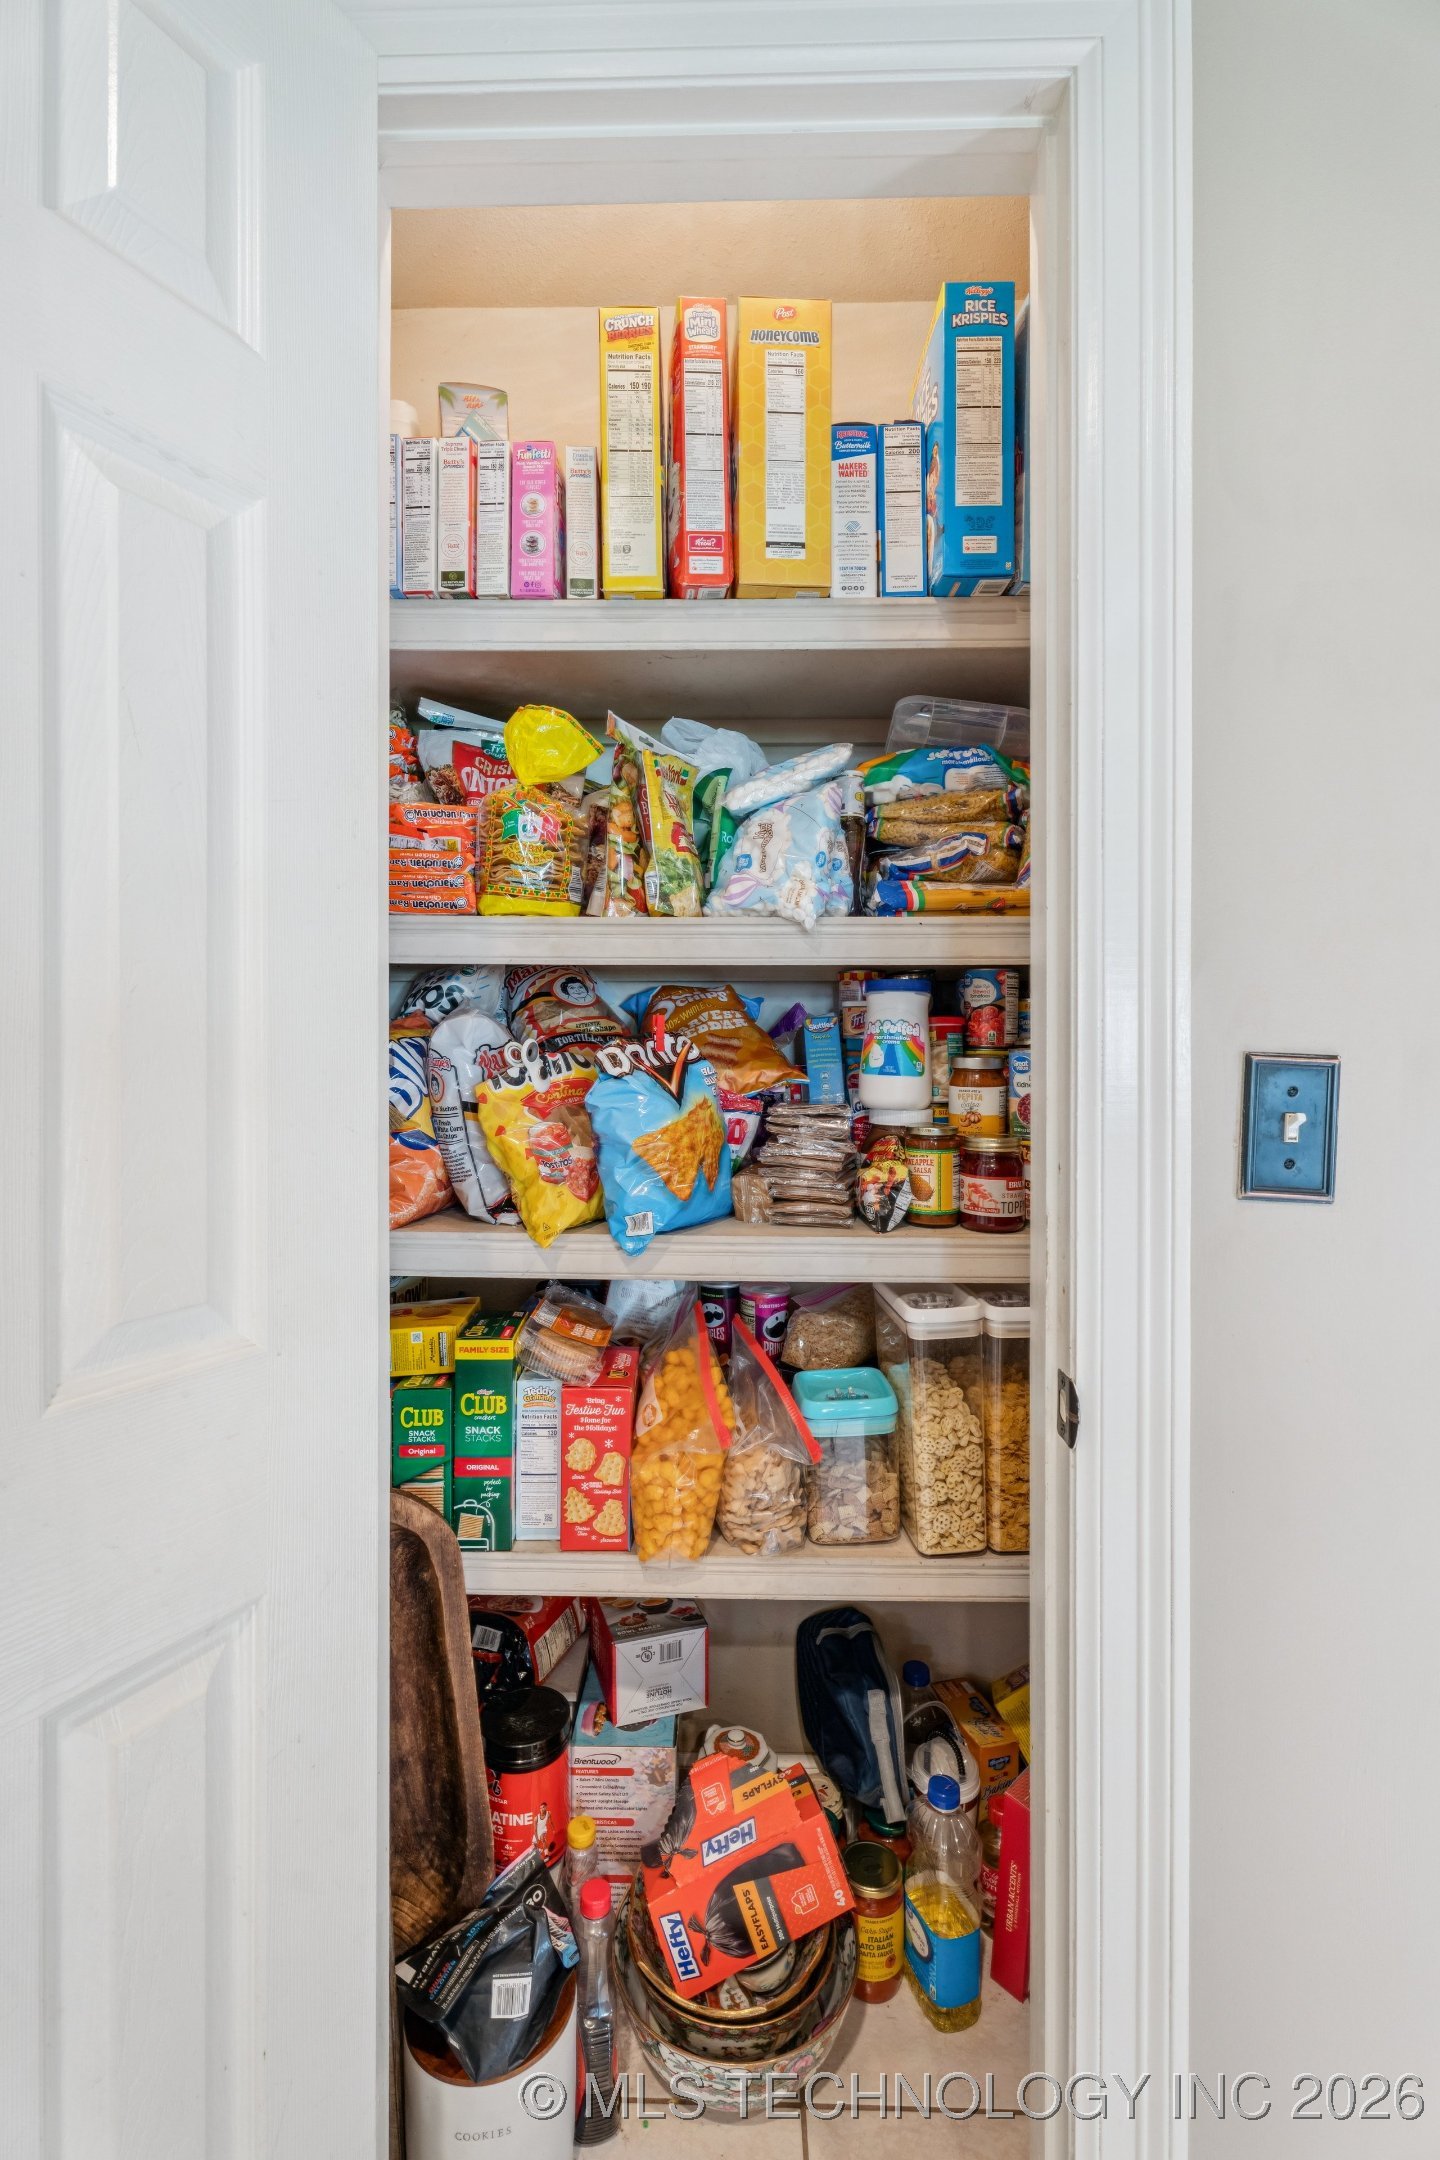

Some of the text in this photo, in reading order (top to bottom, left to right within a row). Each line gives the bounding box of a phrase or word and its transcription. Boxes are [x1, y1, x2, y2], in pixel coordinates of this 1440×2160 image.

[965, 300, 996, 312] RICE
[775, 307, 794, 319] Post
[605, 315, 655, 332] CRUNCH
[951, 312, 1008, 328] KRISPIES
[629, 382, 640, 390] 150
[641, 382, 652, 390] 190
[834, 441, 871, 449] Buttermilk
[838, 462, 868, 470] MAKERS
[838, 470, 868, 478] WANTED
[475, 756, 512, 776] CRIS
[461, 766, 519, 795] ONIO
[413, 809, 457, 818] Maruchan
[410, 858, 460, 869] Maruchan
[412, 879, 459, 888] Maruchan
[412, 900, 458, 910] Maruchan
[808, 1021, 835, 1031] Skittles
[555, 1033, 604, 1046] TORTILLA
[596, 1032, 701, 1078] Dorito
[535, 1083, 585, 1104] Cantina
[957, 1093, 983, 1102] PEPITA
[904, 1158, 934, 1167] NEAPPLE
[1001, 1201, 1024, 1214] TOPP
[708, 1326, 725, 1341] GLES
[458, 1346, 510, 1354] FAMILY SIZE
[763, 1340, 784, 1357] PRIN
[523, 1385, 556, 1396] Teddy
[460, 1392, 508, 1416] CLUB
[586, 1397, 606, 1405] Bring
[565, 1403, 626, 1416] Festive Fun
[400, 1406, 444, 1429] CLUB
[601, 1416, 612, 1424] for
[465, 1426, 502, 1435] SNACK
[464, 1434, 503, 1442] STACKS
[408, 1447, 436, 1457] Original
[646, 1688, 673, 1699] HOTLINE
[573, 1757, 618, 1766] Brentwood
[742, 1775, 785, 1801] SYFLAPS
[492, 1811, 533, 1827] ATINE
[704, 1822, 755, 1858] Hefty
[1005, 1862, 1019, 1933] URBAN ACCENTS
[742, 1888, 770, 1951] EASYFLAPS
[867, 1933, 894, 1943] ITALIAN
[666, 1917, 696, 1978] Hefty
[859, 1943, 875, 1951] ATO
[454, 2126, 512, 2141] COOKIES
